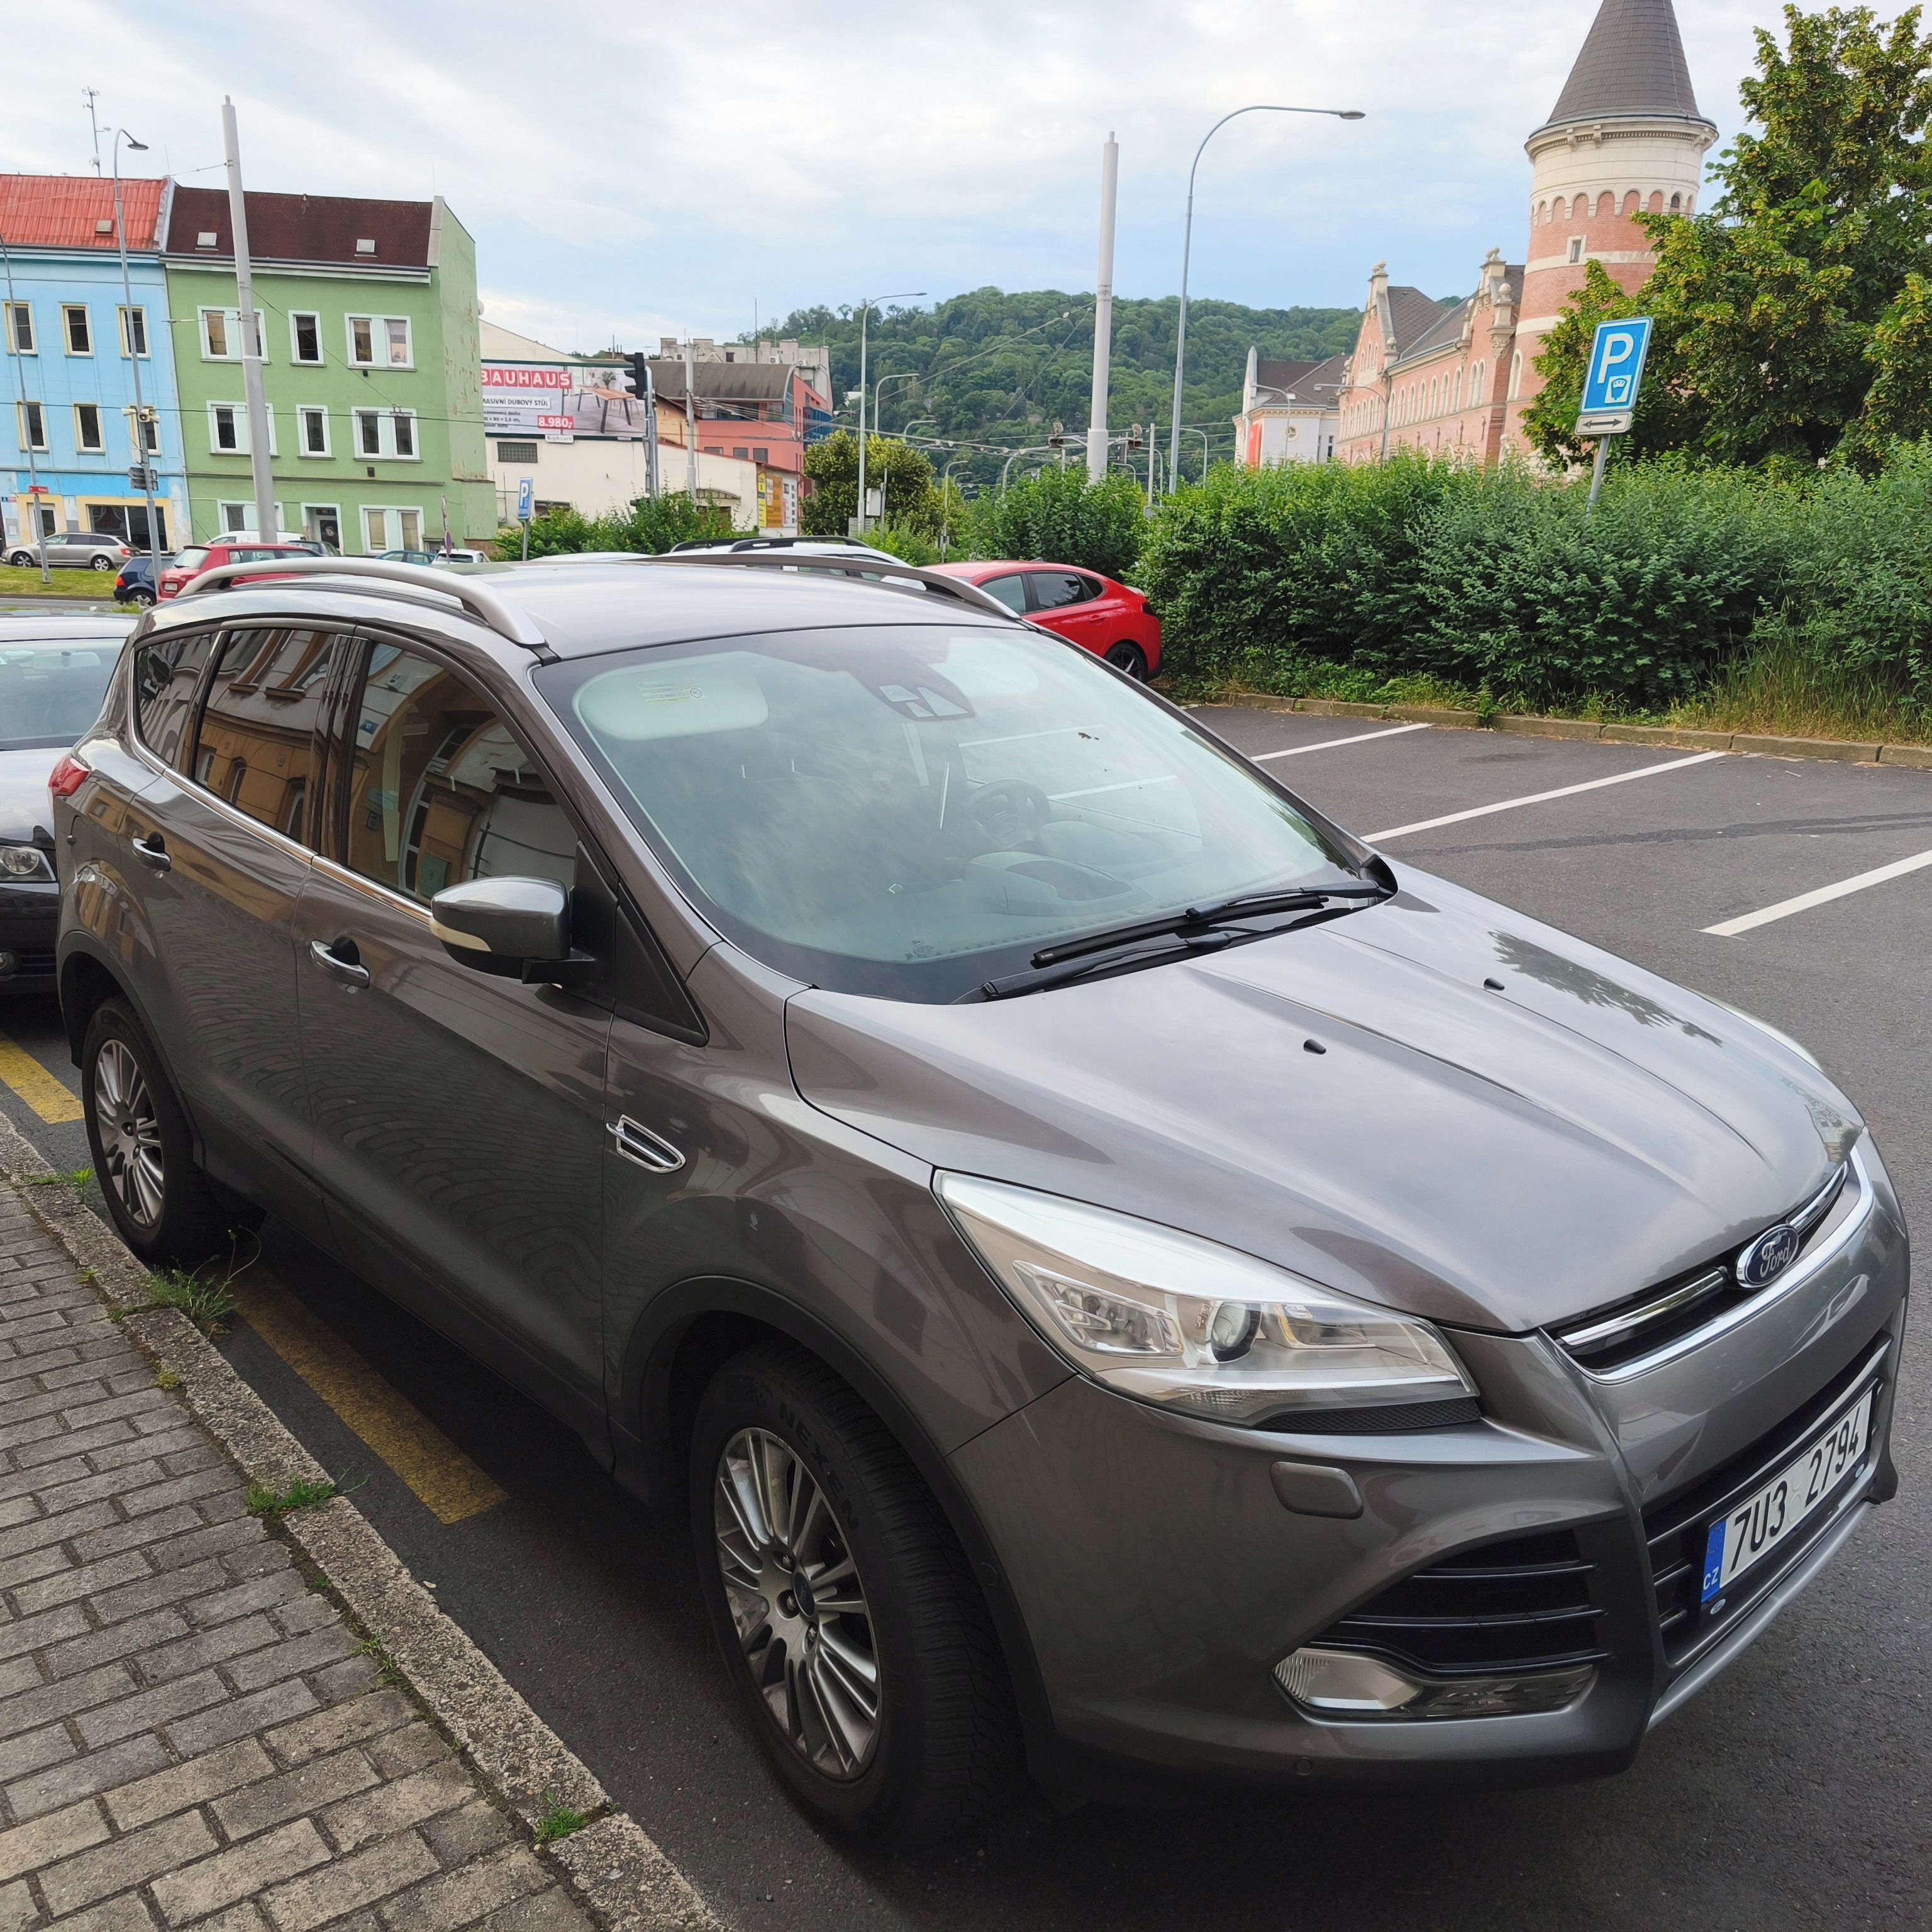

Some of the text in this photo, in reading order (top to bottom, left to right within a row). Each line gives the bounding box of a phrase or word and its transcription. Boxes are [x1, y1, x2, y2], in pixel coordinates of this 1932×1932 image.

[482, 370, 570, 386] BAUHAUS
[1597, 333, 1634, 384] P
[519, 482, 529, 507] P
[1760, 1231, 1792, 1278] Ford
[779, 1401, 860, 1531] NEXEN
[1729, 1406, 1861, 1573] 7U3 2794
[1702, 1565, 1719, 1591] CZ
